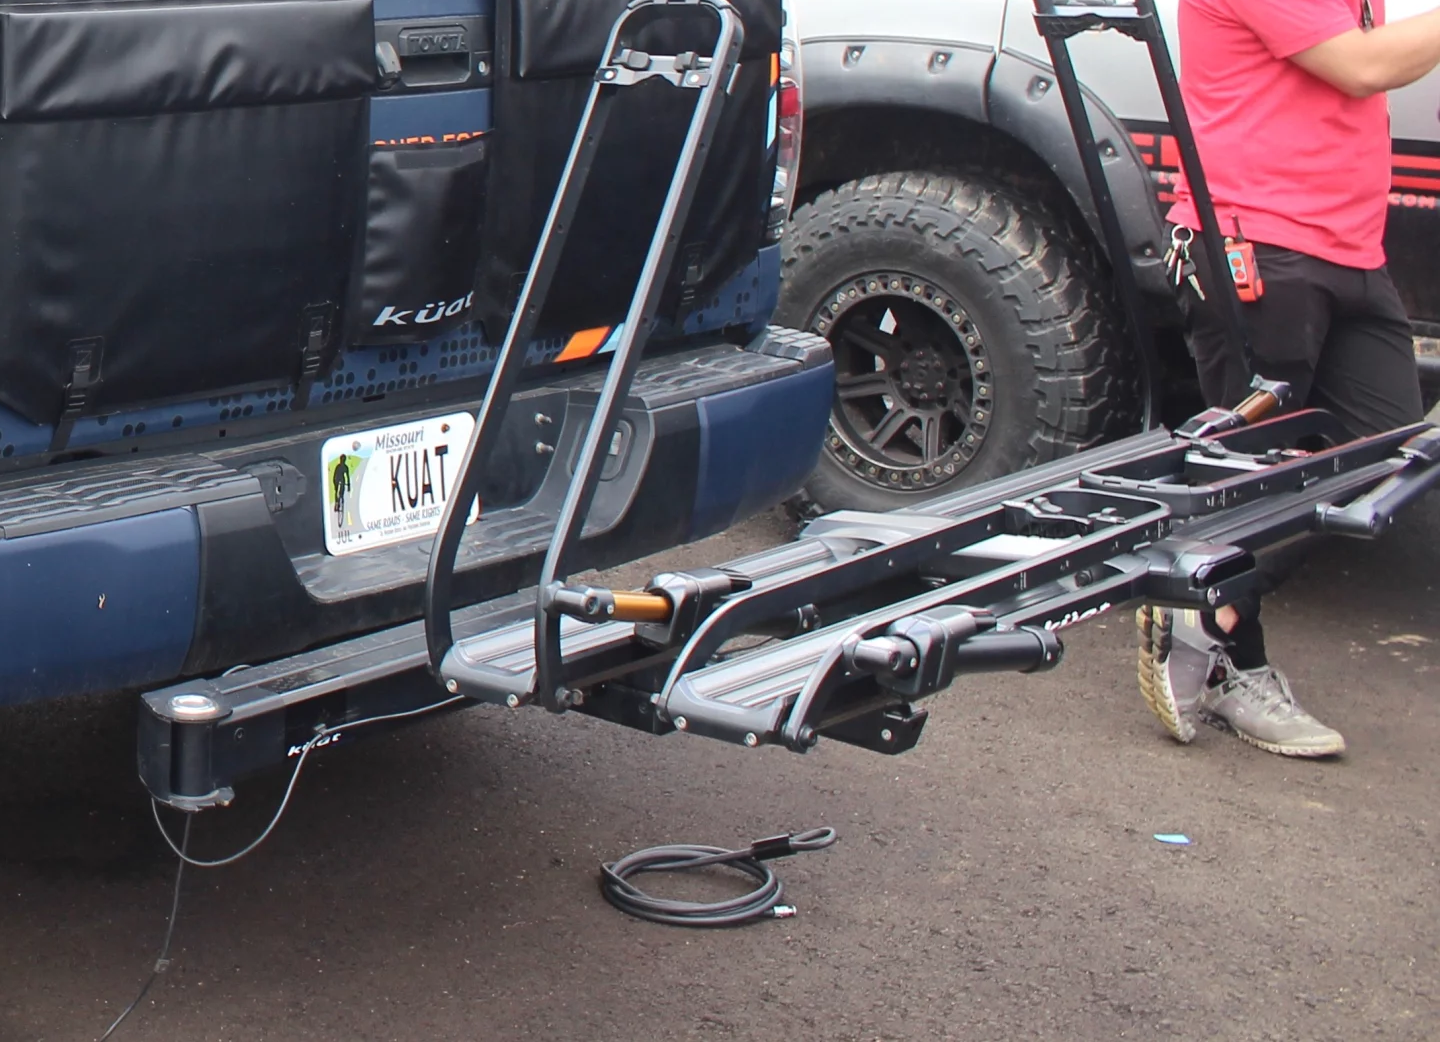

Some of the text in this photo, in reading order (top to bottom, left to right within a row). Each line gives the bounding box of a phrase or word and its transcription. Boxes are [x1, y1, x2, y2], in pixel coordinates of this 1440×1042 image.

[409, 30, 469, 54] TOYOTA
[372, 290, 475, 327] küat
[374, 426, 425, 451] Missouri
[390, 444, 449, 513] KUAT
[336, 529, 353, 545] JUL
